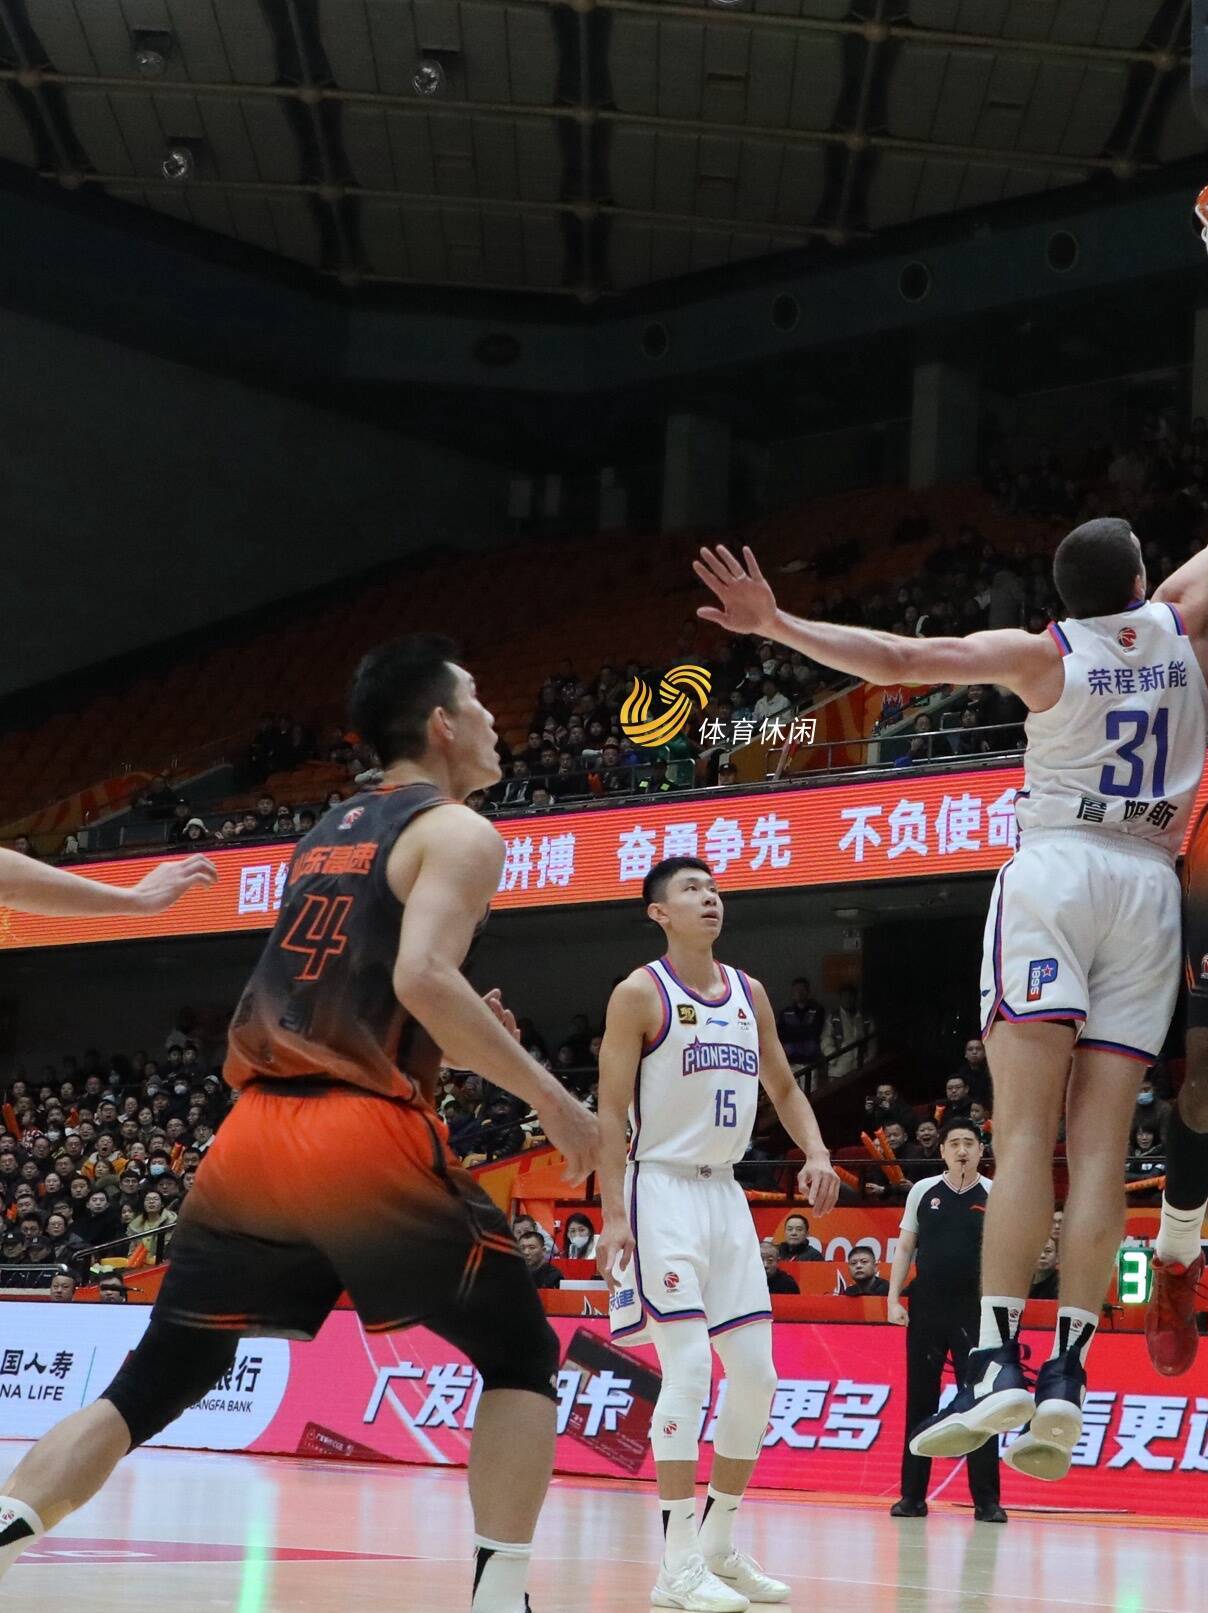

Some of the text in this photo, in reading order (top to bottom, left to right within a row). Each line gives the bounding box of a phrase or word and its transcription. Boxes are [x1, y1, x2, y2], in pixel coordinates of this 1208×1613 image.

[1087, 660, 1188, 697] 荣程新能
[1099, 707, 1169, 798] 31
[280, 893, 354, 981] 4
[682, 1041, 758, 1077] PIONEERS
[714, 1089, 737, 1128] 15
[1122, 1250, 1148, 1304] 3
[28, 1385, 64, 1401] LIFE
[227, 1400, 253, 1412] BANK
